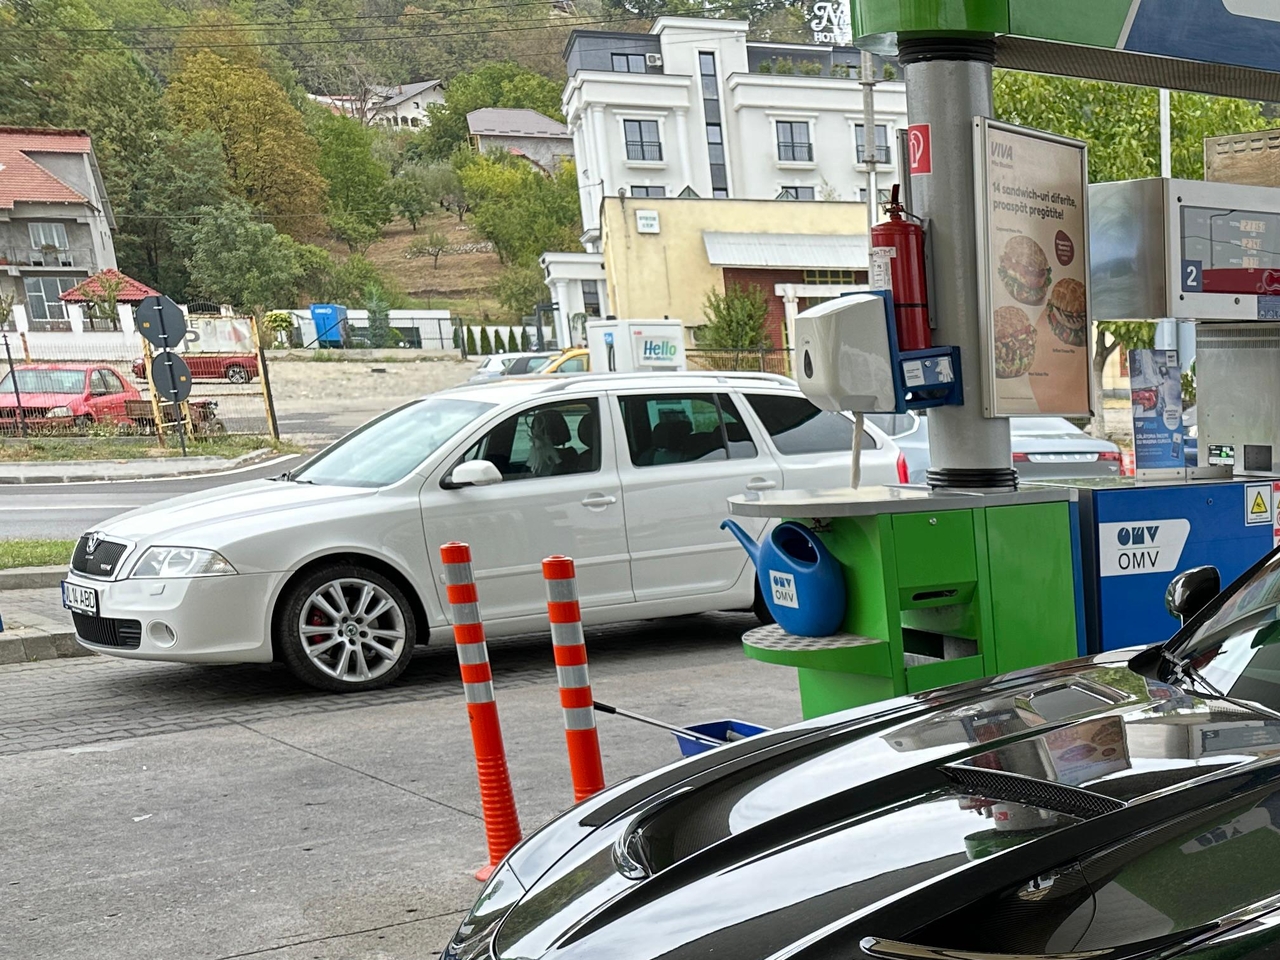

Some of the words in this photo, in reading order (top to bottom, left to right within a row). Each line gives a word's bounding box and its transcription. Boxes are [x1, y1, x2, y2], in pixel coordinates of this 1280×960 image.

[991, 141, 1013, 161] VIVA
[993, 199, 1028, 215] proaspăt
[1029, 204, 1065, 220] pregătite!
[1050, 192, 1077, 209] diferite,
[1186, 265, 1198, 286] 2
[643, 340, 677, 356] Hello
[1117, 526, 1160, 546] OMV
[1118, 550, 1160, 570] OMV
[80, 589, 95, 609] ABD
[775, 590, 794, 603] OMV
